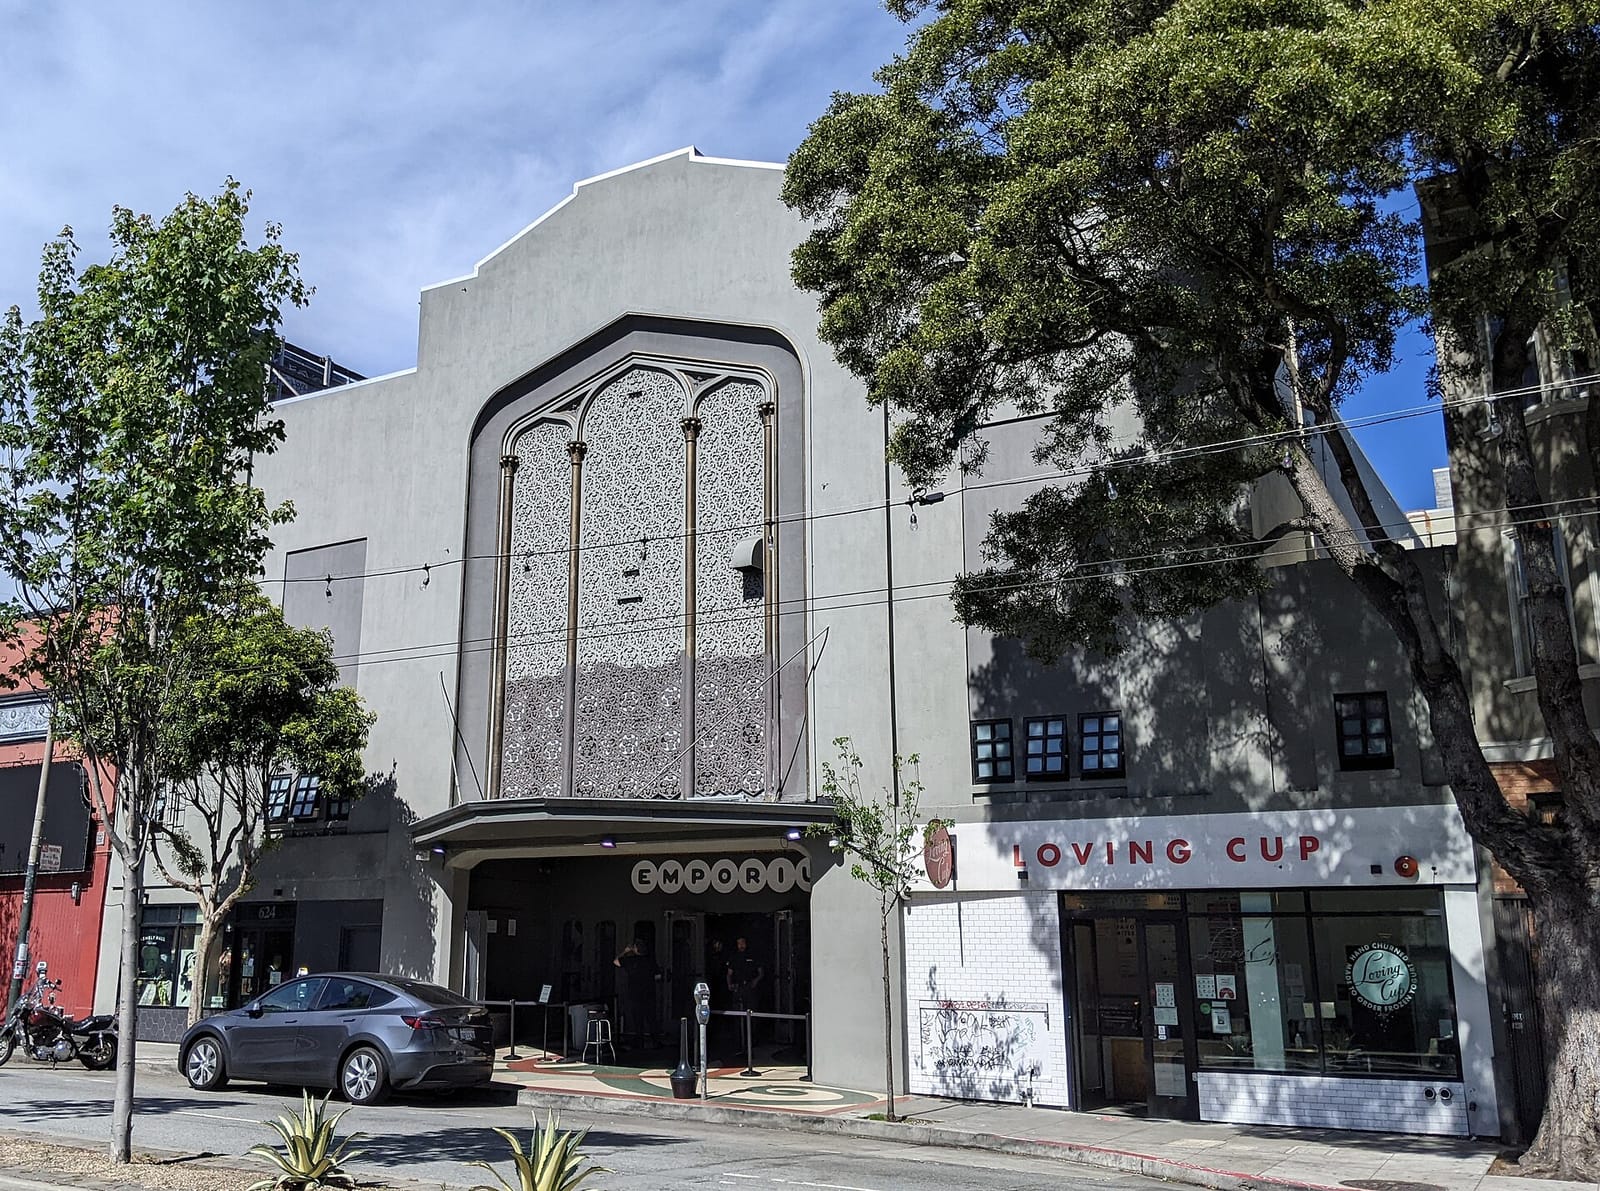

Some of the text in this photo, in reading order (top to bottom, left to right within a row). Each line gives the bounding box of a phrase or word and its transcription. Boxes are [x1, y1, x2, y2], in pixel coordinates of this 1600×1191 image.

[1013, 836, 1320, 868] LOVING CUP
[258, 905, 276, 919] 624
[1349, 942, 1409, 962] HAND CHURNED
[1354, 951, 1405, 987] Loving
[1348, 986, 1358, 996] TO
[1357, 996, 1383, 1012] ORDER
[1384, 995, 1413, 1013] FROZEN
[1381, 978, 1405, 1001] Cup
